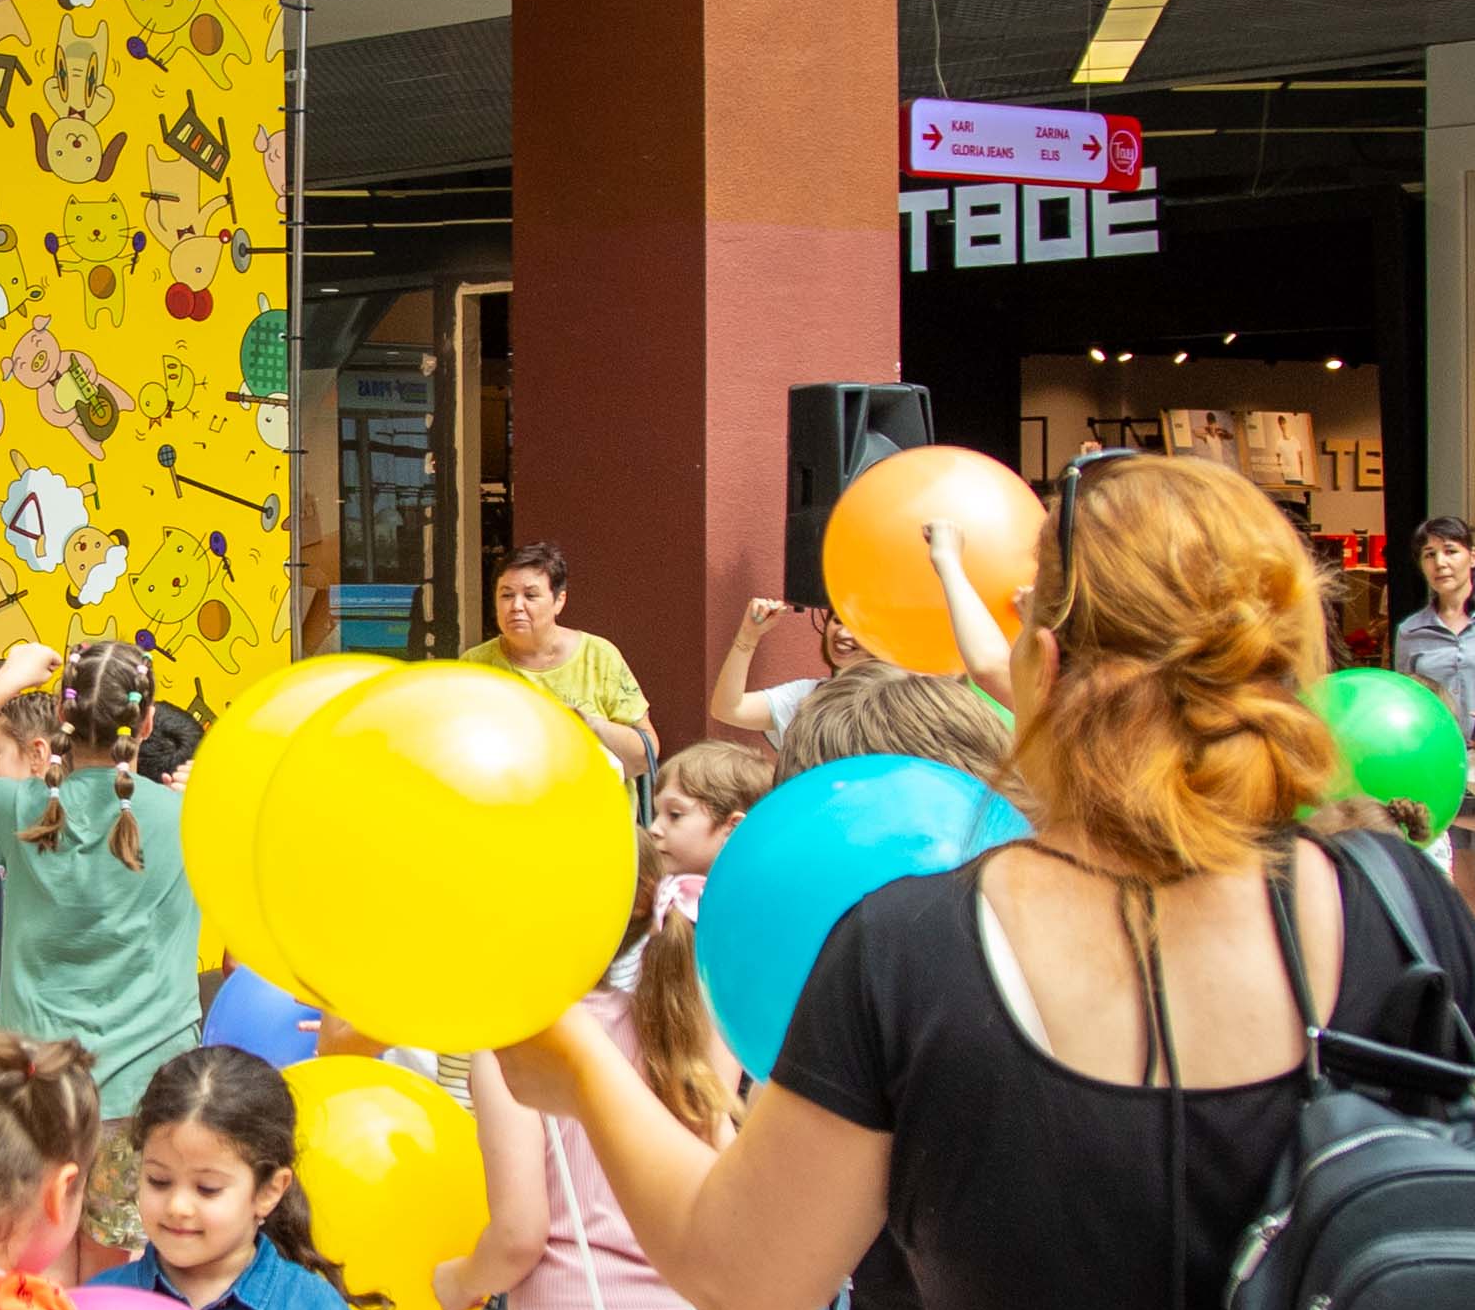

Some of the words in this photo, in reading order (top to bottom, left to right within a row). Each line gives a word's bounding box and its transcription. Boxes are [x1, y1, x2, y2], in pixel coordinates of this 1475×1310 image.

[951, 120, 974, 133] KARI
[1035, 126, 1071, 140] ZARINA
[951, 144, 985, 158] GLORIA
[986, 146, 1015, 159] JEANS
[1040, 149, 1061, 162] ELIS
